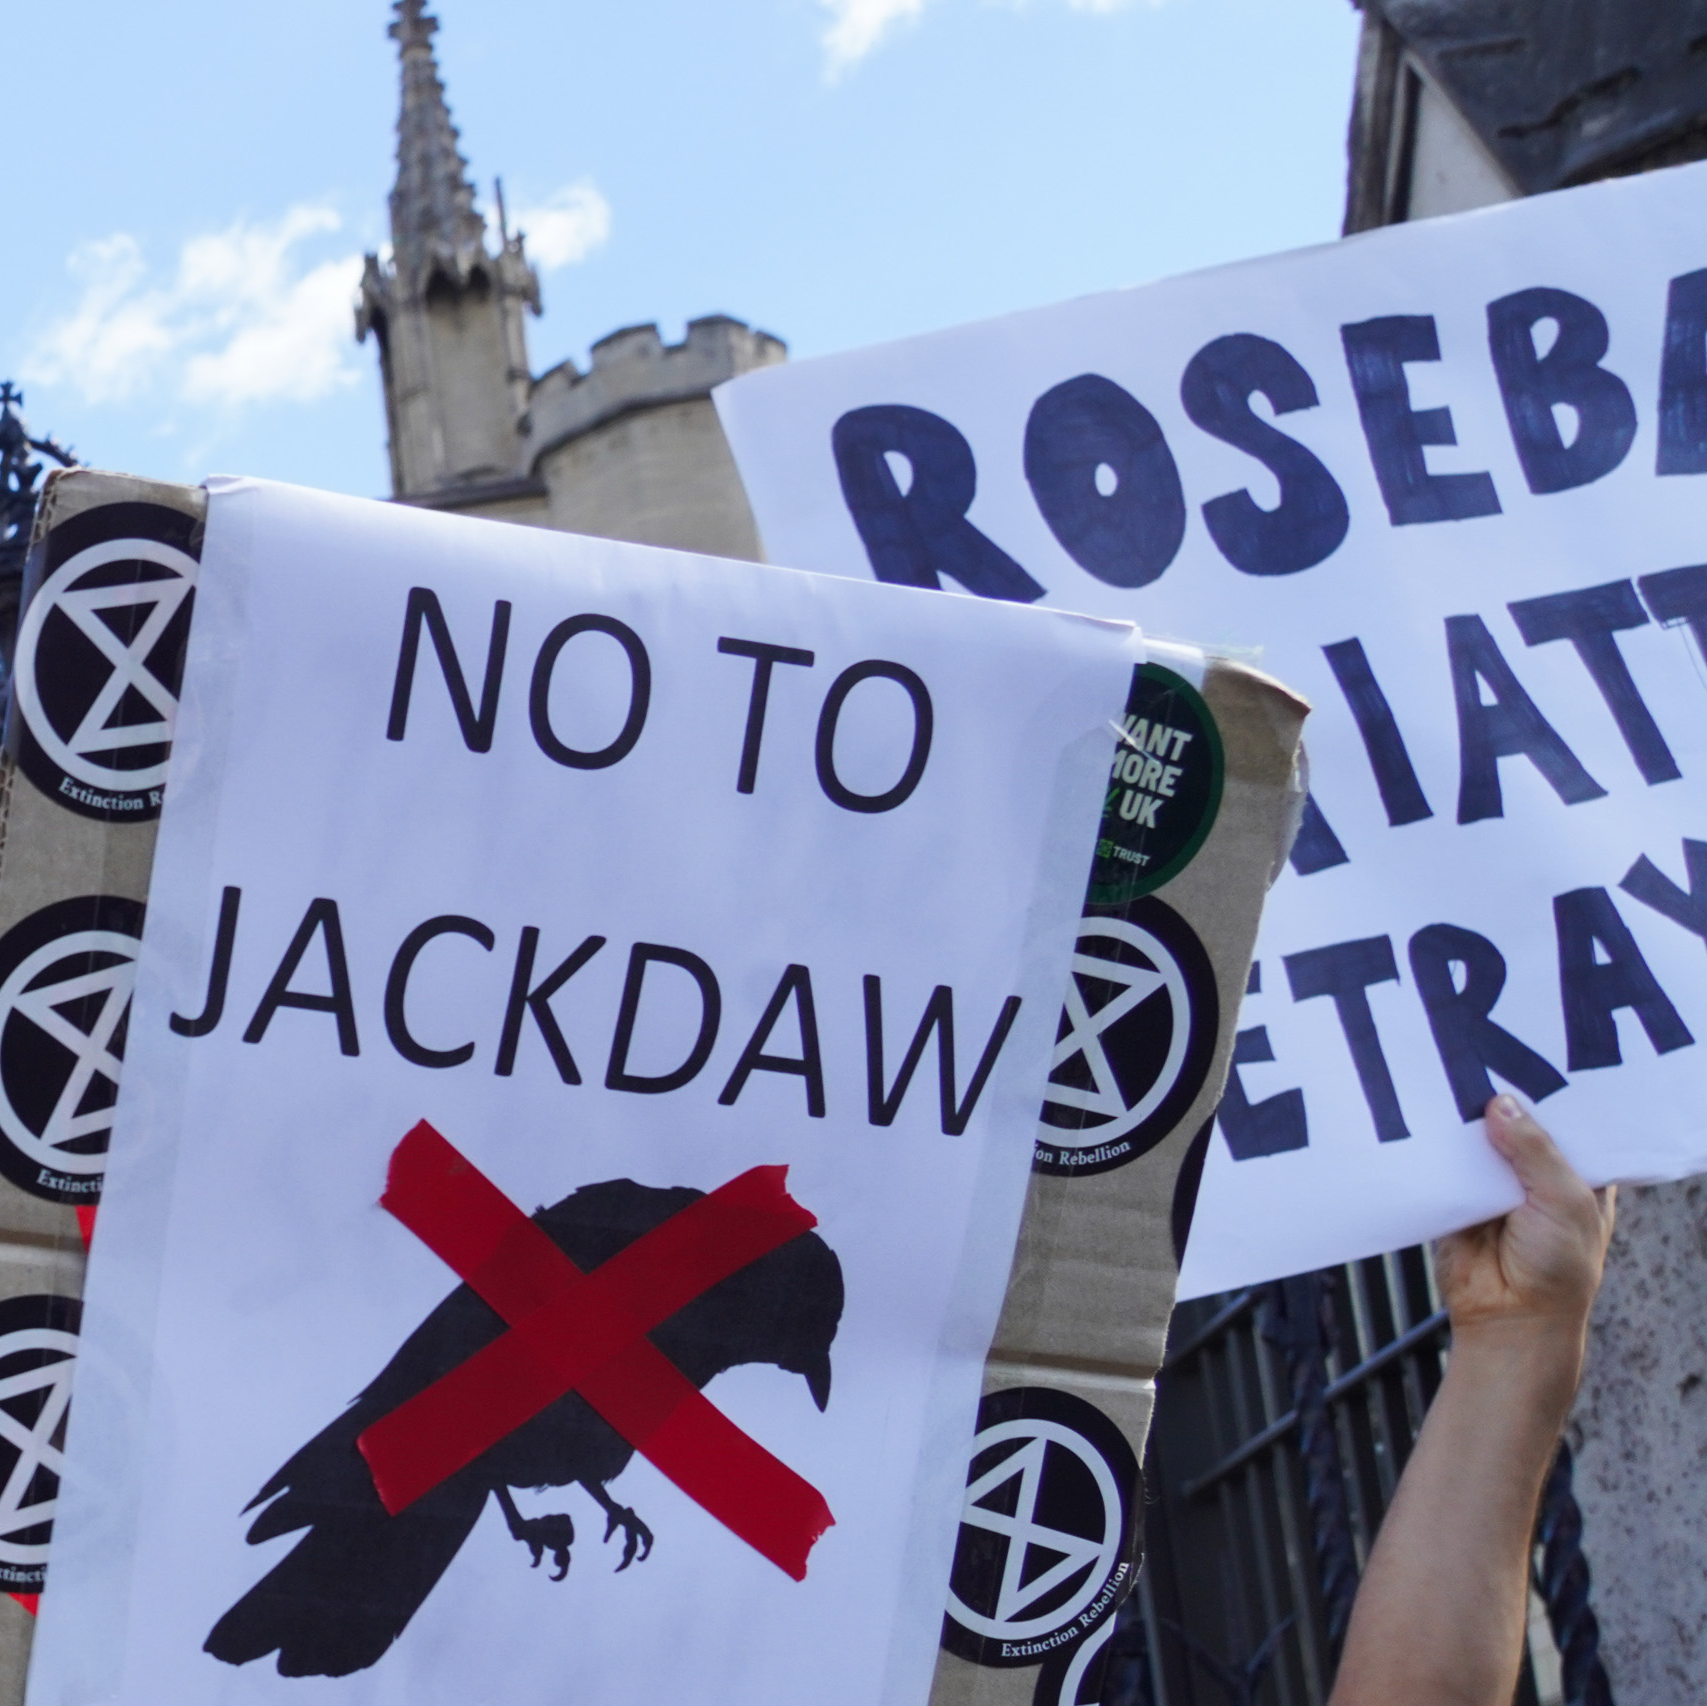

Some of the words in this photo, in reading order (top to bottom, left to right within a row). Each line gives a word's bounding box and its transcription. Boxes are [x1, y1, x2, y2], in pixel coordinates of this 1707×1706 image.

[387, 587, 651, 770] NO
[718, 637, 933, 813] TO
[59, 776, 144, 811] Extinction
[1119, 789, 1164, 829] UK
[1113, 846, 1150, 867] TRUST
[169, 886, 1022, 1136] JACKDAW
[1058, 1141, 1131, 1165] Rebellion
[1001, 1626, 1078, 1657] Extinction
[1078, 1561, 1129, 1628] Rebellion
